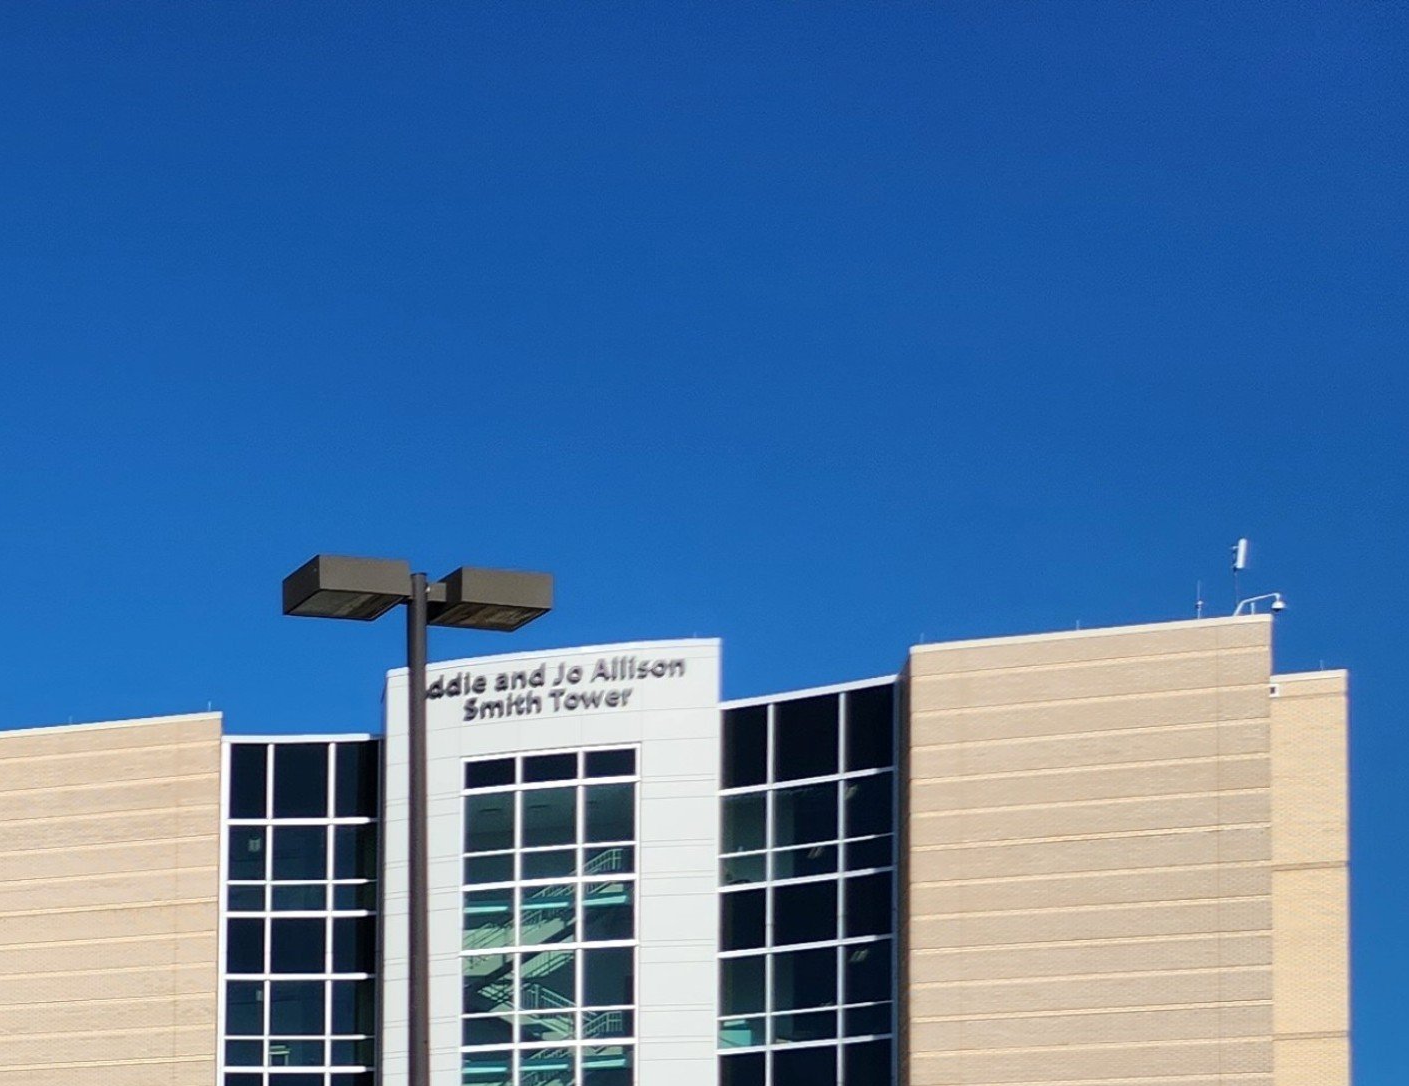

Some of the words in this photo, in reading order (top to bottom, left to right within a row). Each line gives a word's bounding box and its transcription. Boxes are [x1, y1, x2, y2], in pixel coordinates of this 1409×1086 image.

[425, 672, 487, 700] ddie
[494, 663, 545, 692] and
[553, 662, 584, 686] Jo
[591, 656, 686, 682] Allison
[463, 691, 542, 721] Smith
[550, 686, 633, 713] Tower
